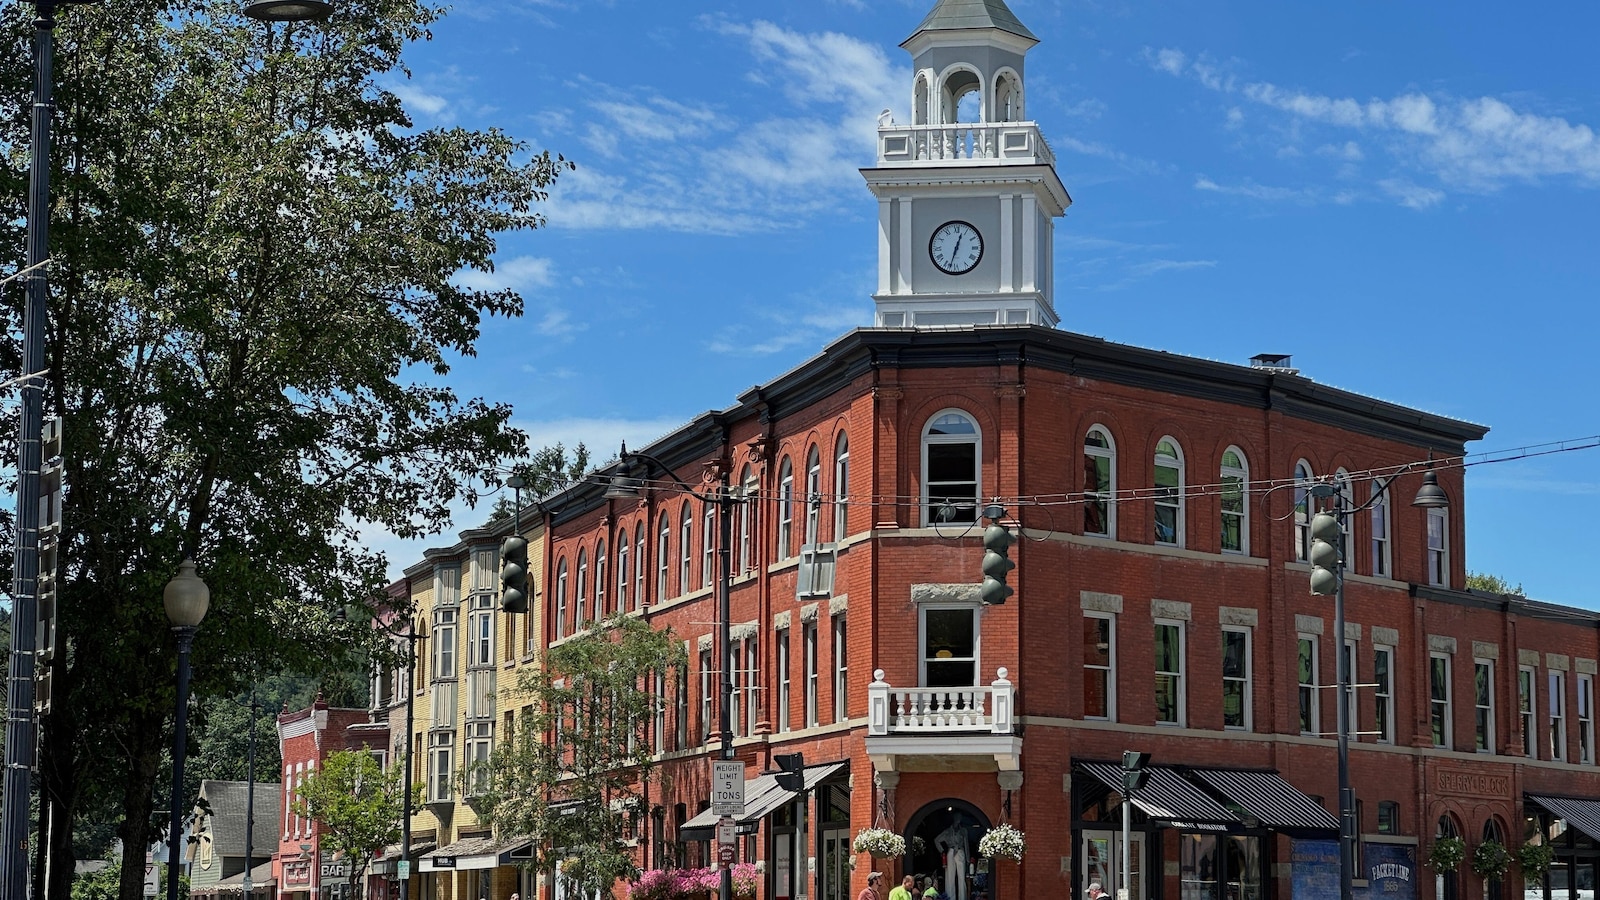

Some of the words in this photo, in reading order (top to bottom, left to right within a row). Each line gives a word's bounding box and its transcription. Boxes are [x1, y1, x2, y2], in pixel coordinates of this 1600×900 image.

[725, 781, 732, 790] 5
[1439, 774, 1472, 791] SPERRY
[1479, 776, 1508, 794] BLOCK
[717, 791, 741, 800] TONS
[1196, 823, 1228, 831] BOOKSTORE
[321, 865, 345, 876] BAR
[1371, 863, 1395, 881] PACKET
[1395, 863, 1410, 882] LINE
